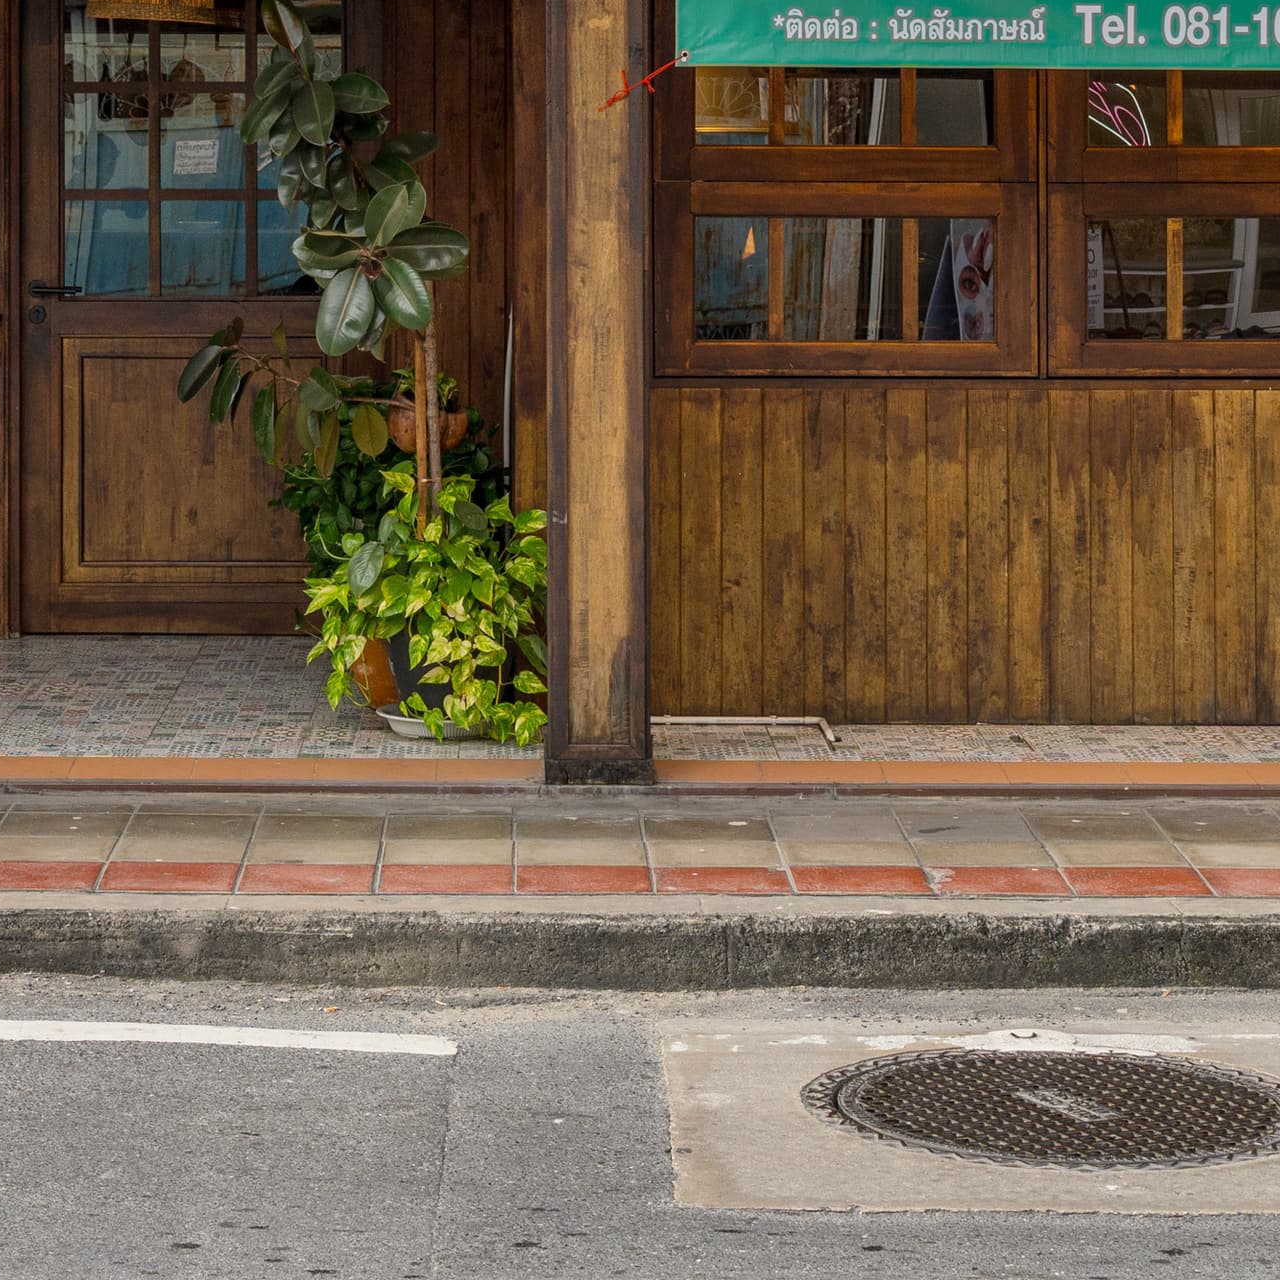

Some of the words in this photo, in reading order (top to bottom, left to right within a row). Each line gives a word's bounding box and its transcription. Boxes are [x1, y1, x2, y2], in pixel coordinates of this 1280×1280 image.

[869, 19, 879, 41] :
[887, 5, 1047, 42] นัดสัมภาษณ์
[1074, 3, 1148, 47] Tel.
